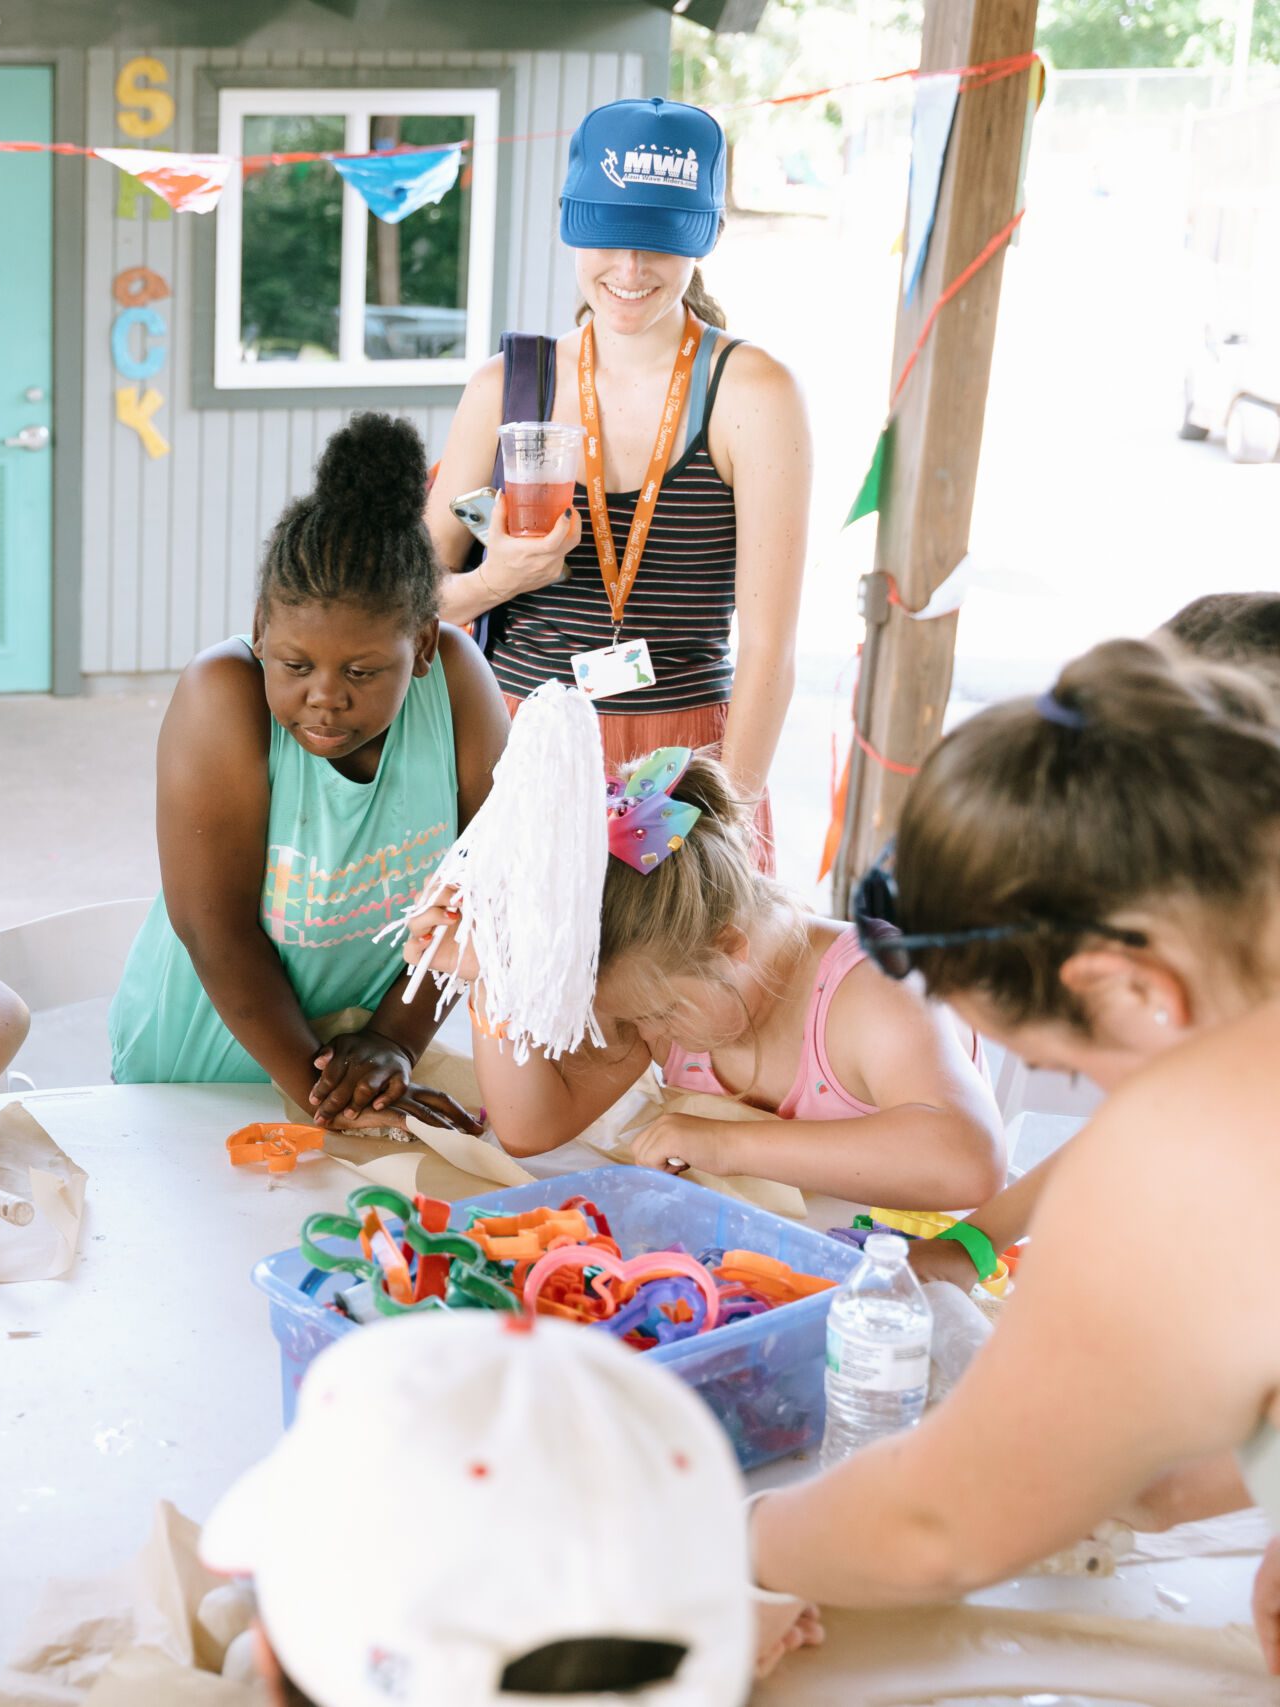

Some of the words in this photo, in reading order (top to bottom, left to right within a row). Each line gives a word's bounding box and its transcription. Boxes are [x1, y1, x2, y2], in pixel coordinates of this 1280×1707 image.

[623, 151, 699, 182] MWR
[672, 370, 686, 397] Small
[664, 397, 680, 423] Town
[592, 476, 605, 512] Summer
[596, 512, 610, 538] Town
[630, 519, 647, 546] Small
[601, 538, 614, 566] Small
[624, 547, 640, 572] Town
